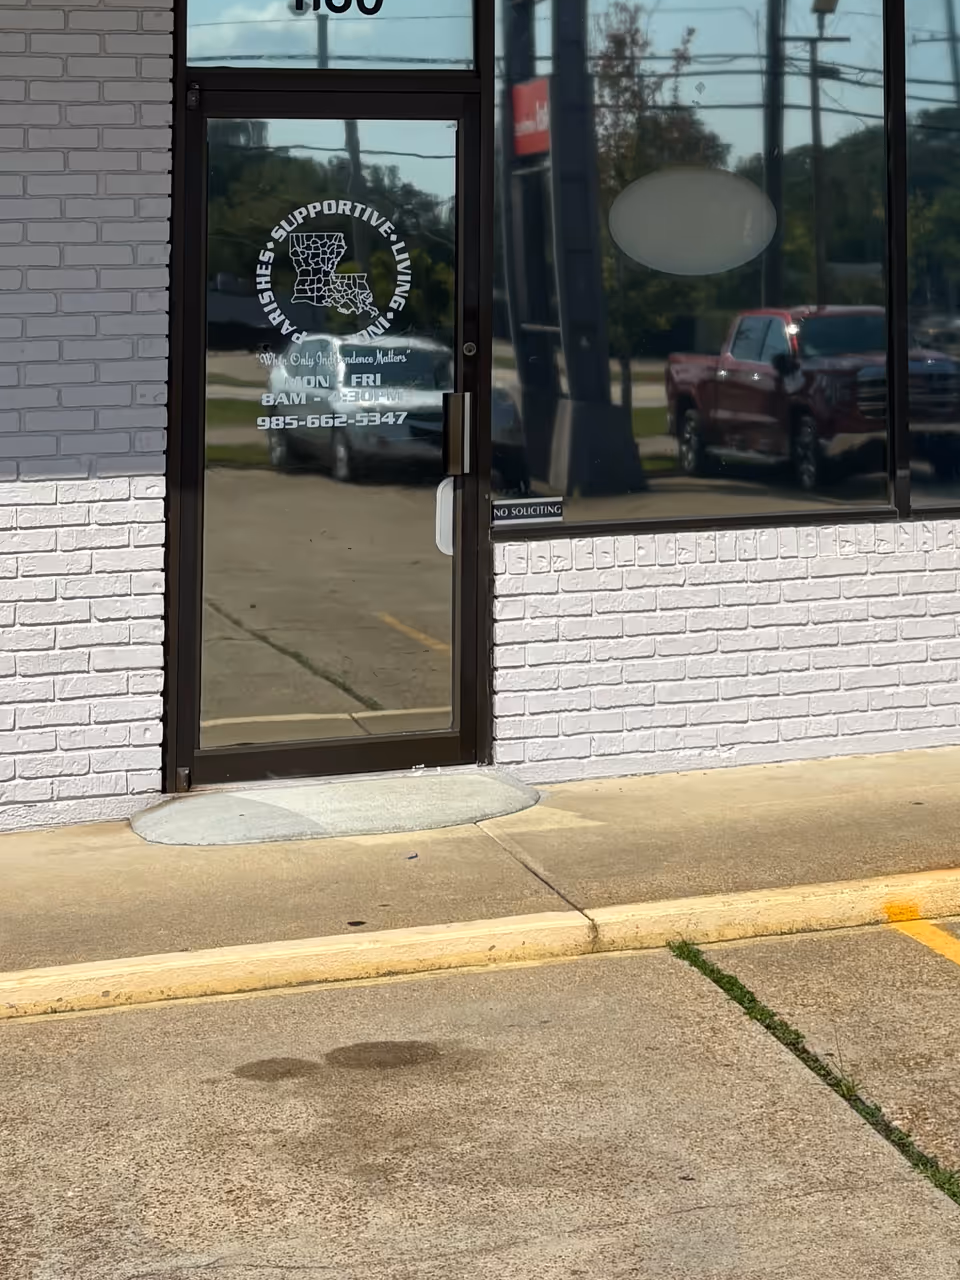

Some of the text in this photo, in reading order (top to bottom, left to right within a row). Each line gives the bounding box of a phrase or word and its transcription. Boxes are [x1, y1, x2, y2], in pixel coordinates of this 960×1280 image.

[256, 200, 412, 345] PARISHES SUPPORTIVE LIVING INC
[290, 351, 315, 368] Only
[285, 375, 330, 388] MON
[351, 373, 381, 387] FRI
[261, 392, 306, 406] 8AM
[327, 388, 403, 404] 4:30PM
[257, 411, 408, 430] 985-662-5347
[493, 504, 562, 517] NO SOLICITING
